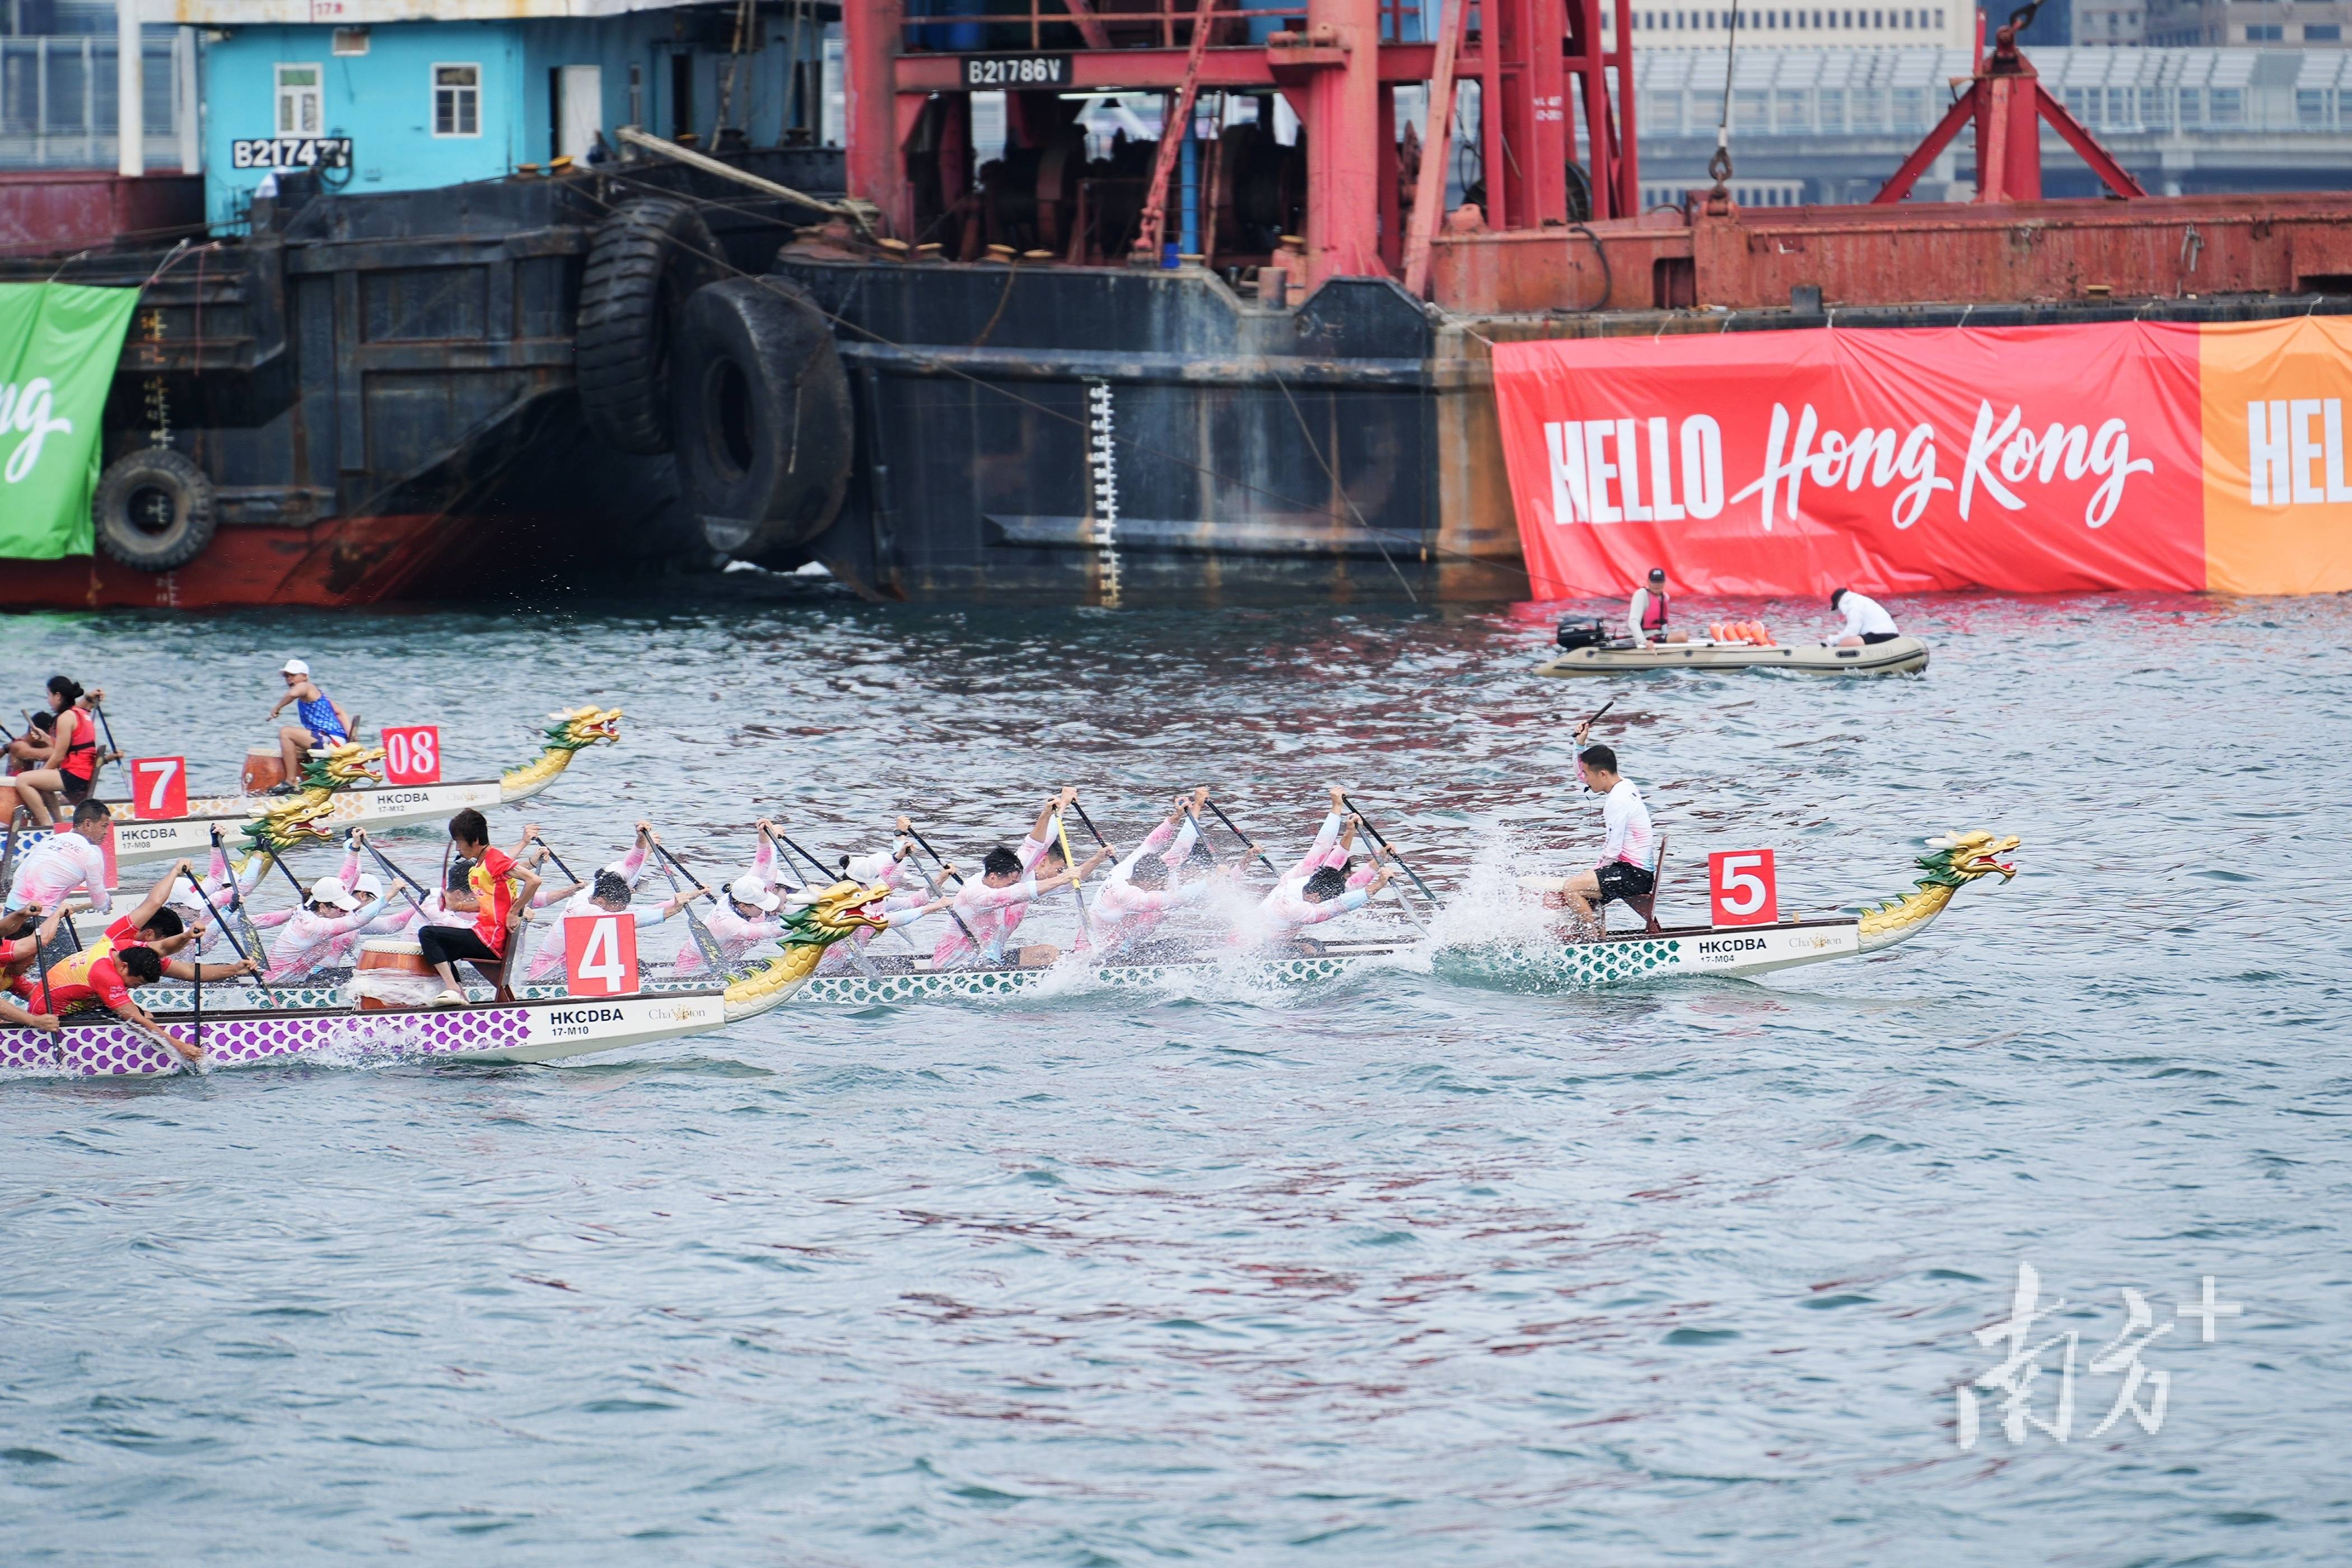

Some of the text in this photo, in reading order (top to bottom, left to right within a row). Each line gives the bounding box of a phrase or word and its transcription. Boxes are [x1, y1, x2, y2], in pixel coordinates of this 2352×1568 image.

[969, 58, 1061, 84] B21786V
[1544, 399, 2154, 531] HELLO Hong Kong
[388, 731, 434, 774] 08
[139, 760, 178, 809] 7
[377, 793, 429, 804] HKCDBA
[122, 828, 178, 841] HKCDBA
[1720, 855, 1766, 916] 5
[577, 917, 626, 992] 4
[1699, 938, 1767, 954] HKCDBA
[550, 1008, 624, 1025] HKCDBA
[552, 1026, 589, 1037] 17-M10
